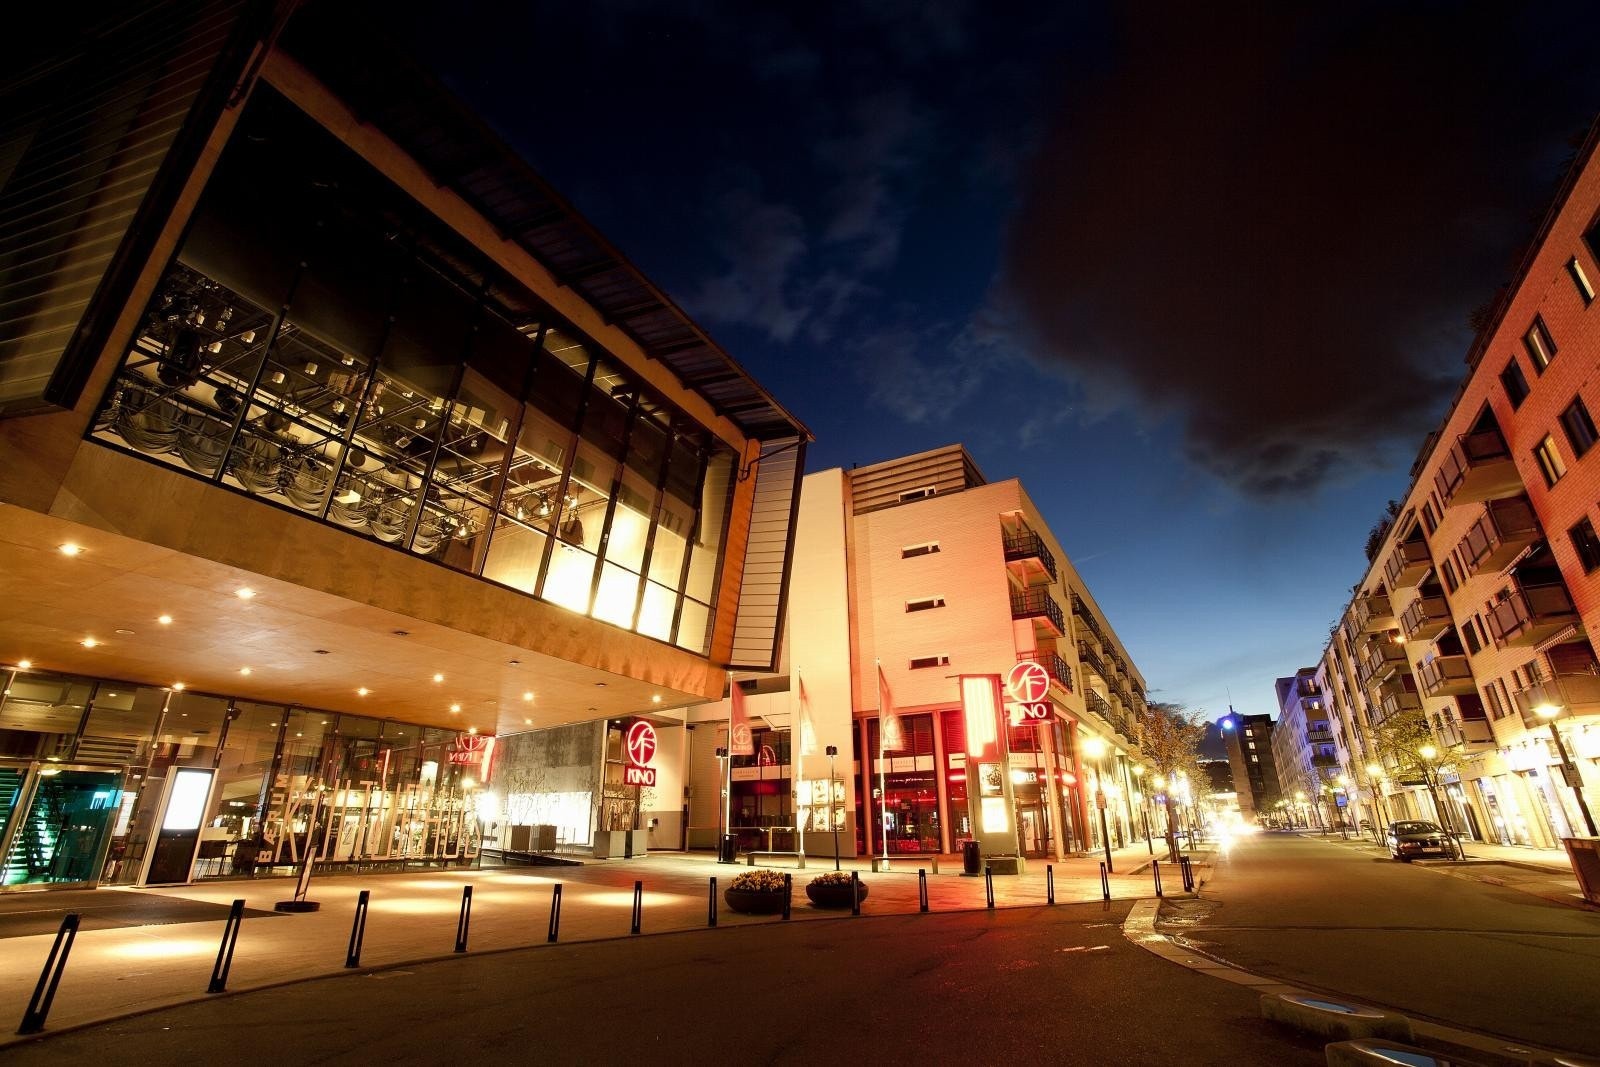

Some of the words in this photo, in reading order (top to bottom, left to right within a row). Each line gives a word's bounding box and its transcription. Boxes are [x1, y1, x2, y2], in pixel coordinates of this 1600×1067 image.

[258, 774, 289, 862] BÆRUM
[274, 776, 481, 862] KULTURHUS
[627, 770, 655, 785] KINO
